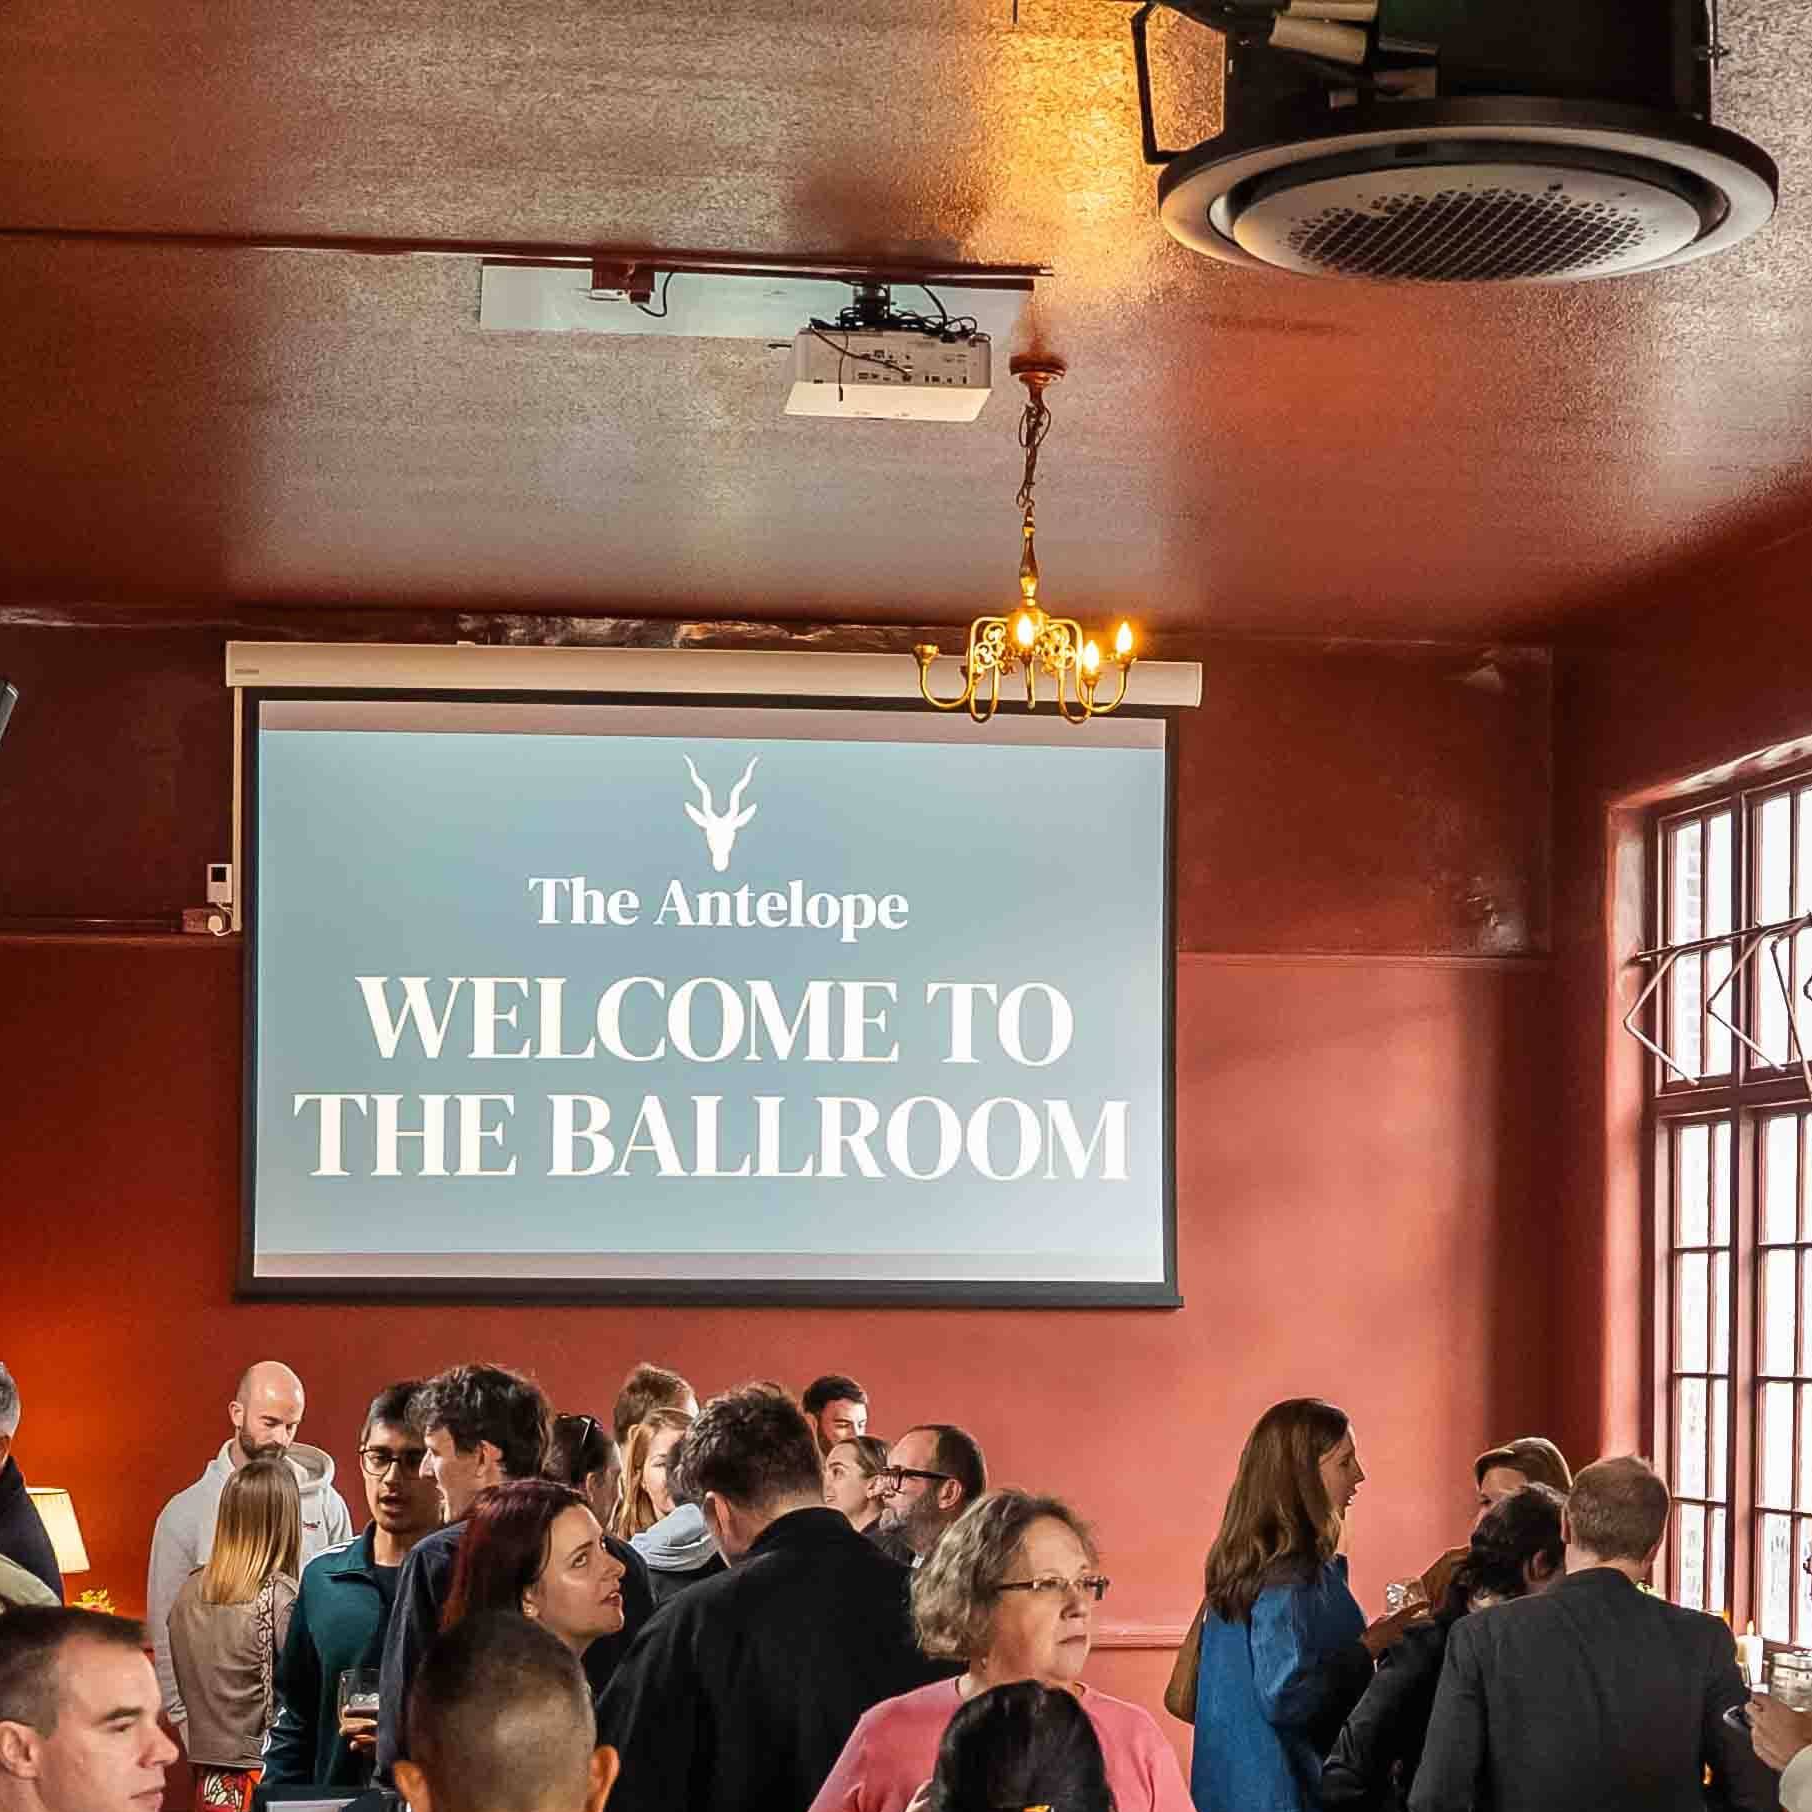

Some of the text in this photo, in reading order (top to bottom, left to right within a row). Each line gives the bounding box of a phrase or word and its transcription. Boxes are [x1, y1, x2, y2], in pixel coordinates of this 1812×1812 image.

[528, 876, 909, 943] The Antelope
[354, 976, 1075, 1067] WELCOME TO
[294, 1093, 1130, 1181] THE BALLROOM
